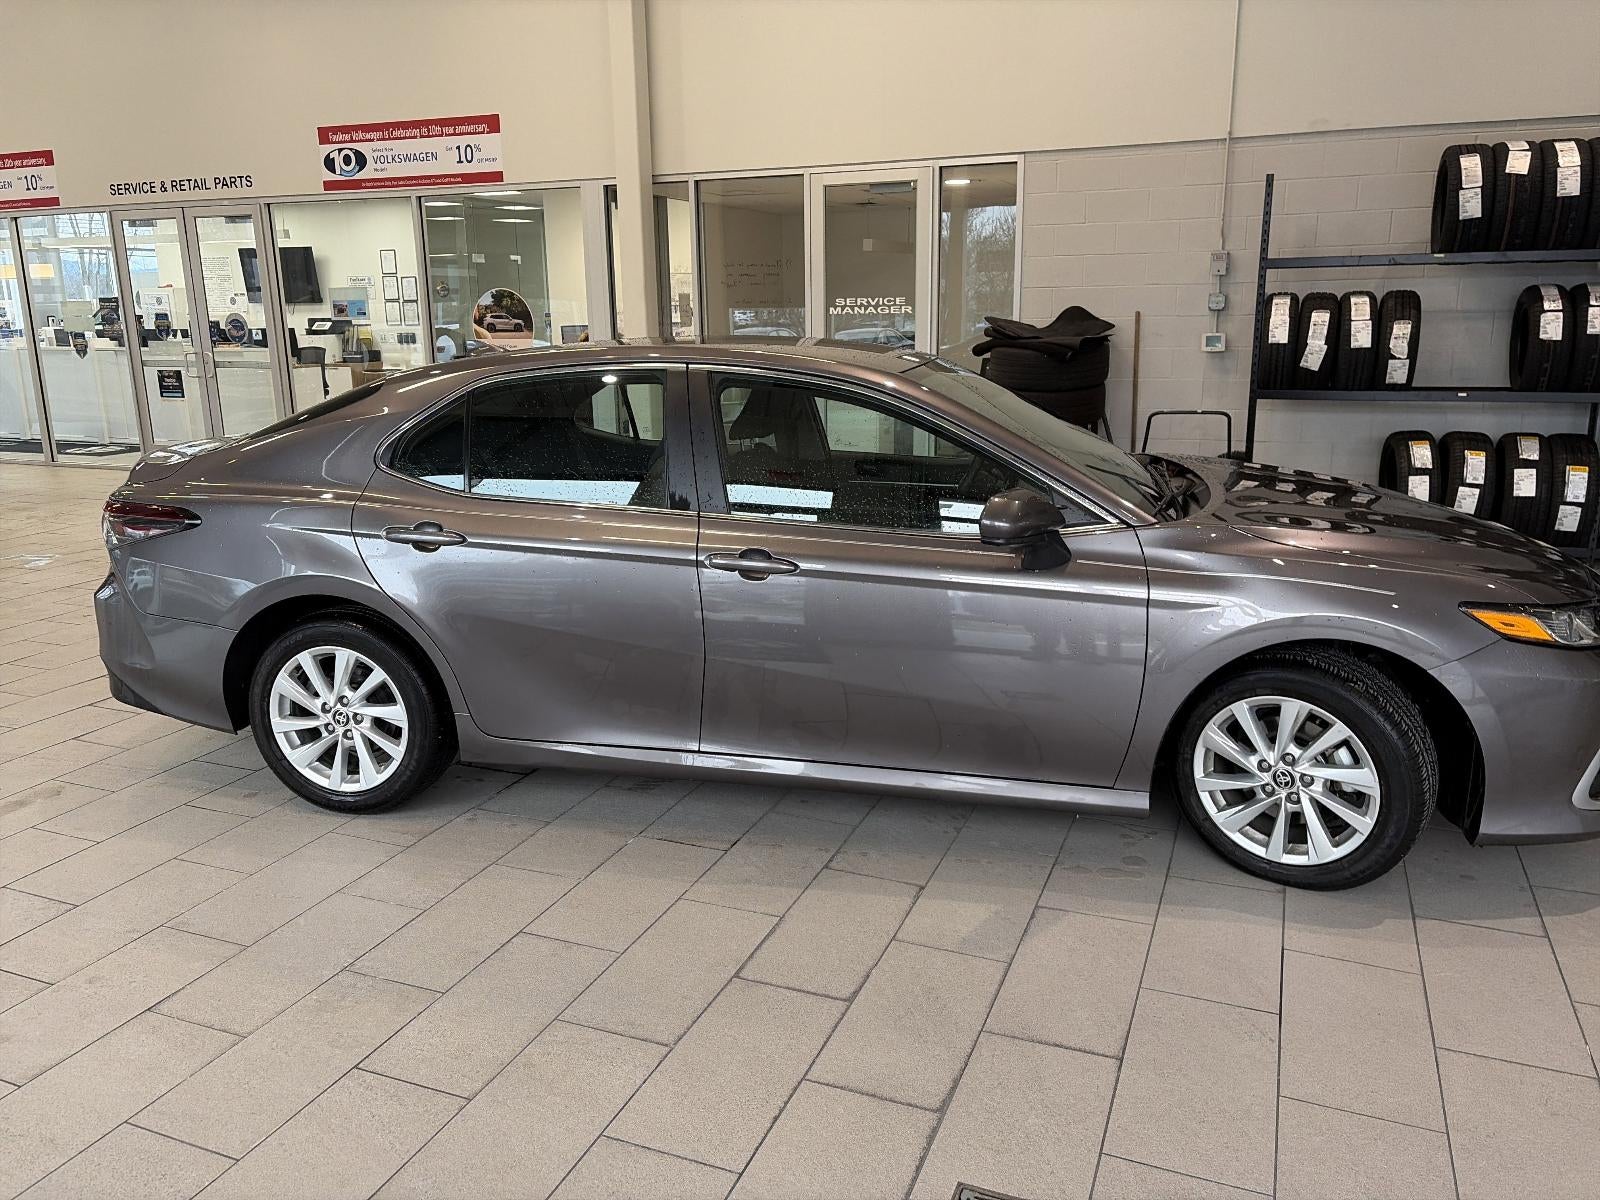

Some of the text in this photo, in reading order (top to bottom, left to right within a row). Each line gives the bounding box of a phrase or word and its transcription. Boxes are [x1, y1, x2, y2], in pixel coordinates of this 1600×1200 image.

[329, 131, 351, 142] Faulkner
[352, 130, 383, 141] Volkswagen
[384, 129, 389, 138] is
[389, 126, 420, 138] Celebrating
[429, 124, 442, 135] 10th
[443, 126, 454, 136] year
[330, 149, 356, 174] 10
[372, 151, 438, 165] VOLKSWAGEN
[109, 175, 253, 196] SERVICE & RETAIL PARTS
[835, 297, 906, 306] SERVICE
[829, 306, 913, 315] MANAGER
